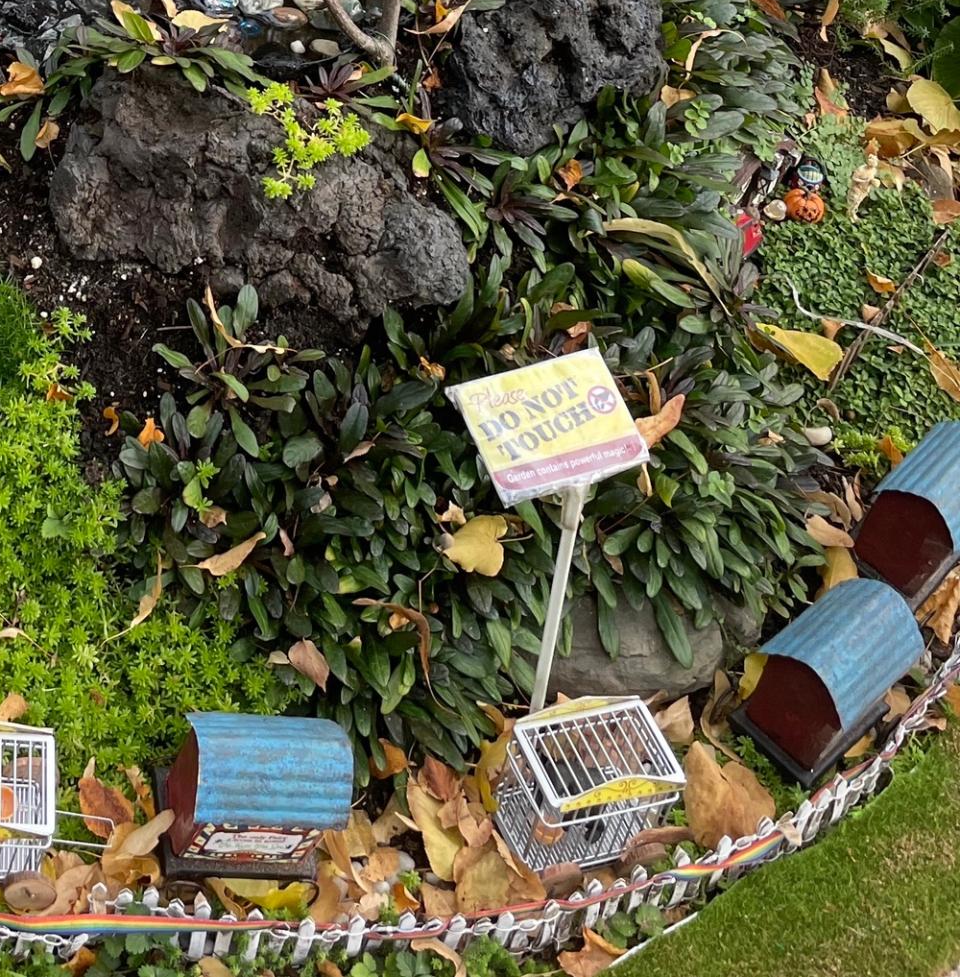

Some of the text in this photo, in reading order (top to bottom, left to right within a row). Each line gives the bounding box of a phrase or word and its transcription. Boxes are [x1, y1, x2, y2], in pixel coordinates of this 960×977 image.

[469, 387, 528, 412] Please
[478, 376, 580, 442] DO NOT
[496, 400, 596, 461] TOUCH
[506, 469, 536, 484] Garden
[537, 460, 569, 477] contains
[570, 451, 603, 469] powerful
